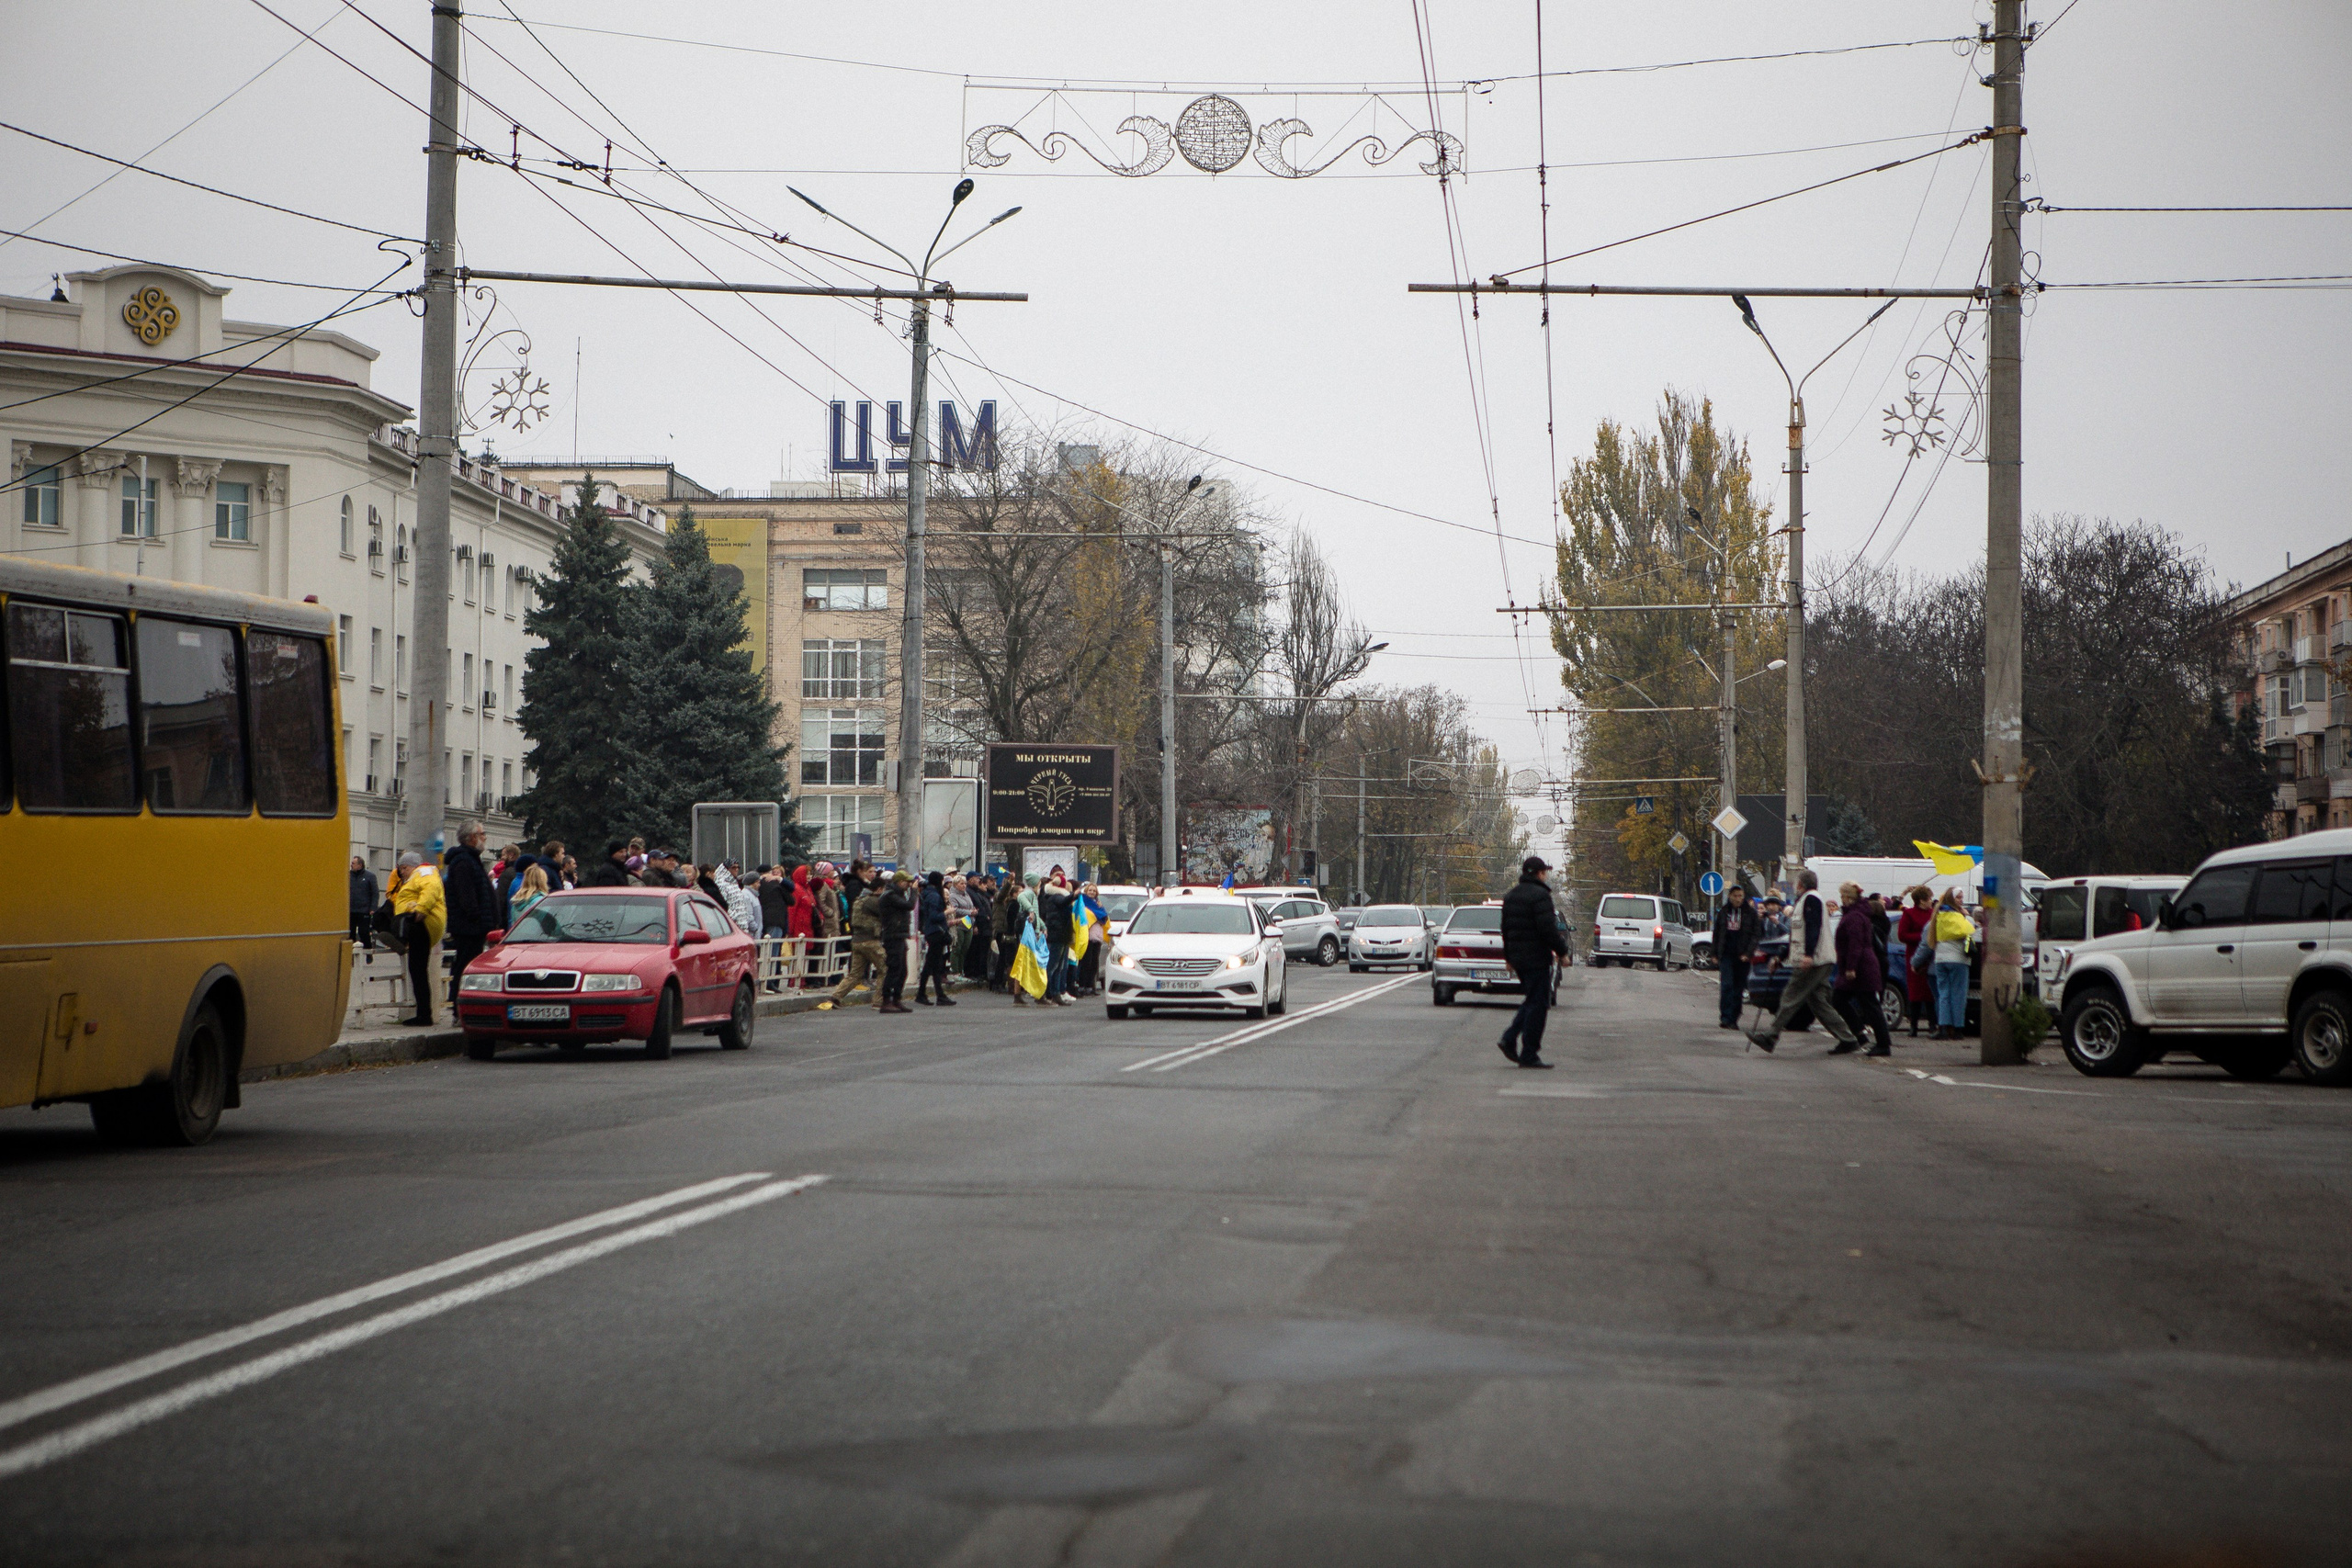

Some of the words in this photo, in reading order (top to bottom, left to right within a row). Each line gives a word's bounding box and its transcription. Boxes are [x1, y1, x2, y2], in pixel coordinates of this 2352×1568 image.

[830, 400, 997, 473] ЦУМ
[1015, 753, 1034, 762] МЫ
[1036, 754, 1091, 763] ОТКРЫТЫ
[1030, 768, 1057, 784] ЧЕРНЫЙ
[1058, 771, 1072, 785] ГУСЬ
[997, 826, 1038, 835] Попробуй
[1040, 828, 1072, 836] эмоции
